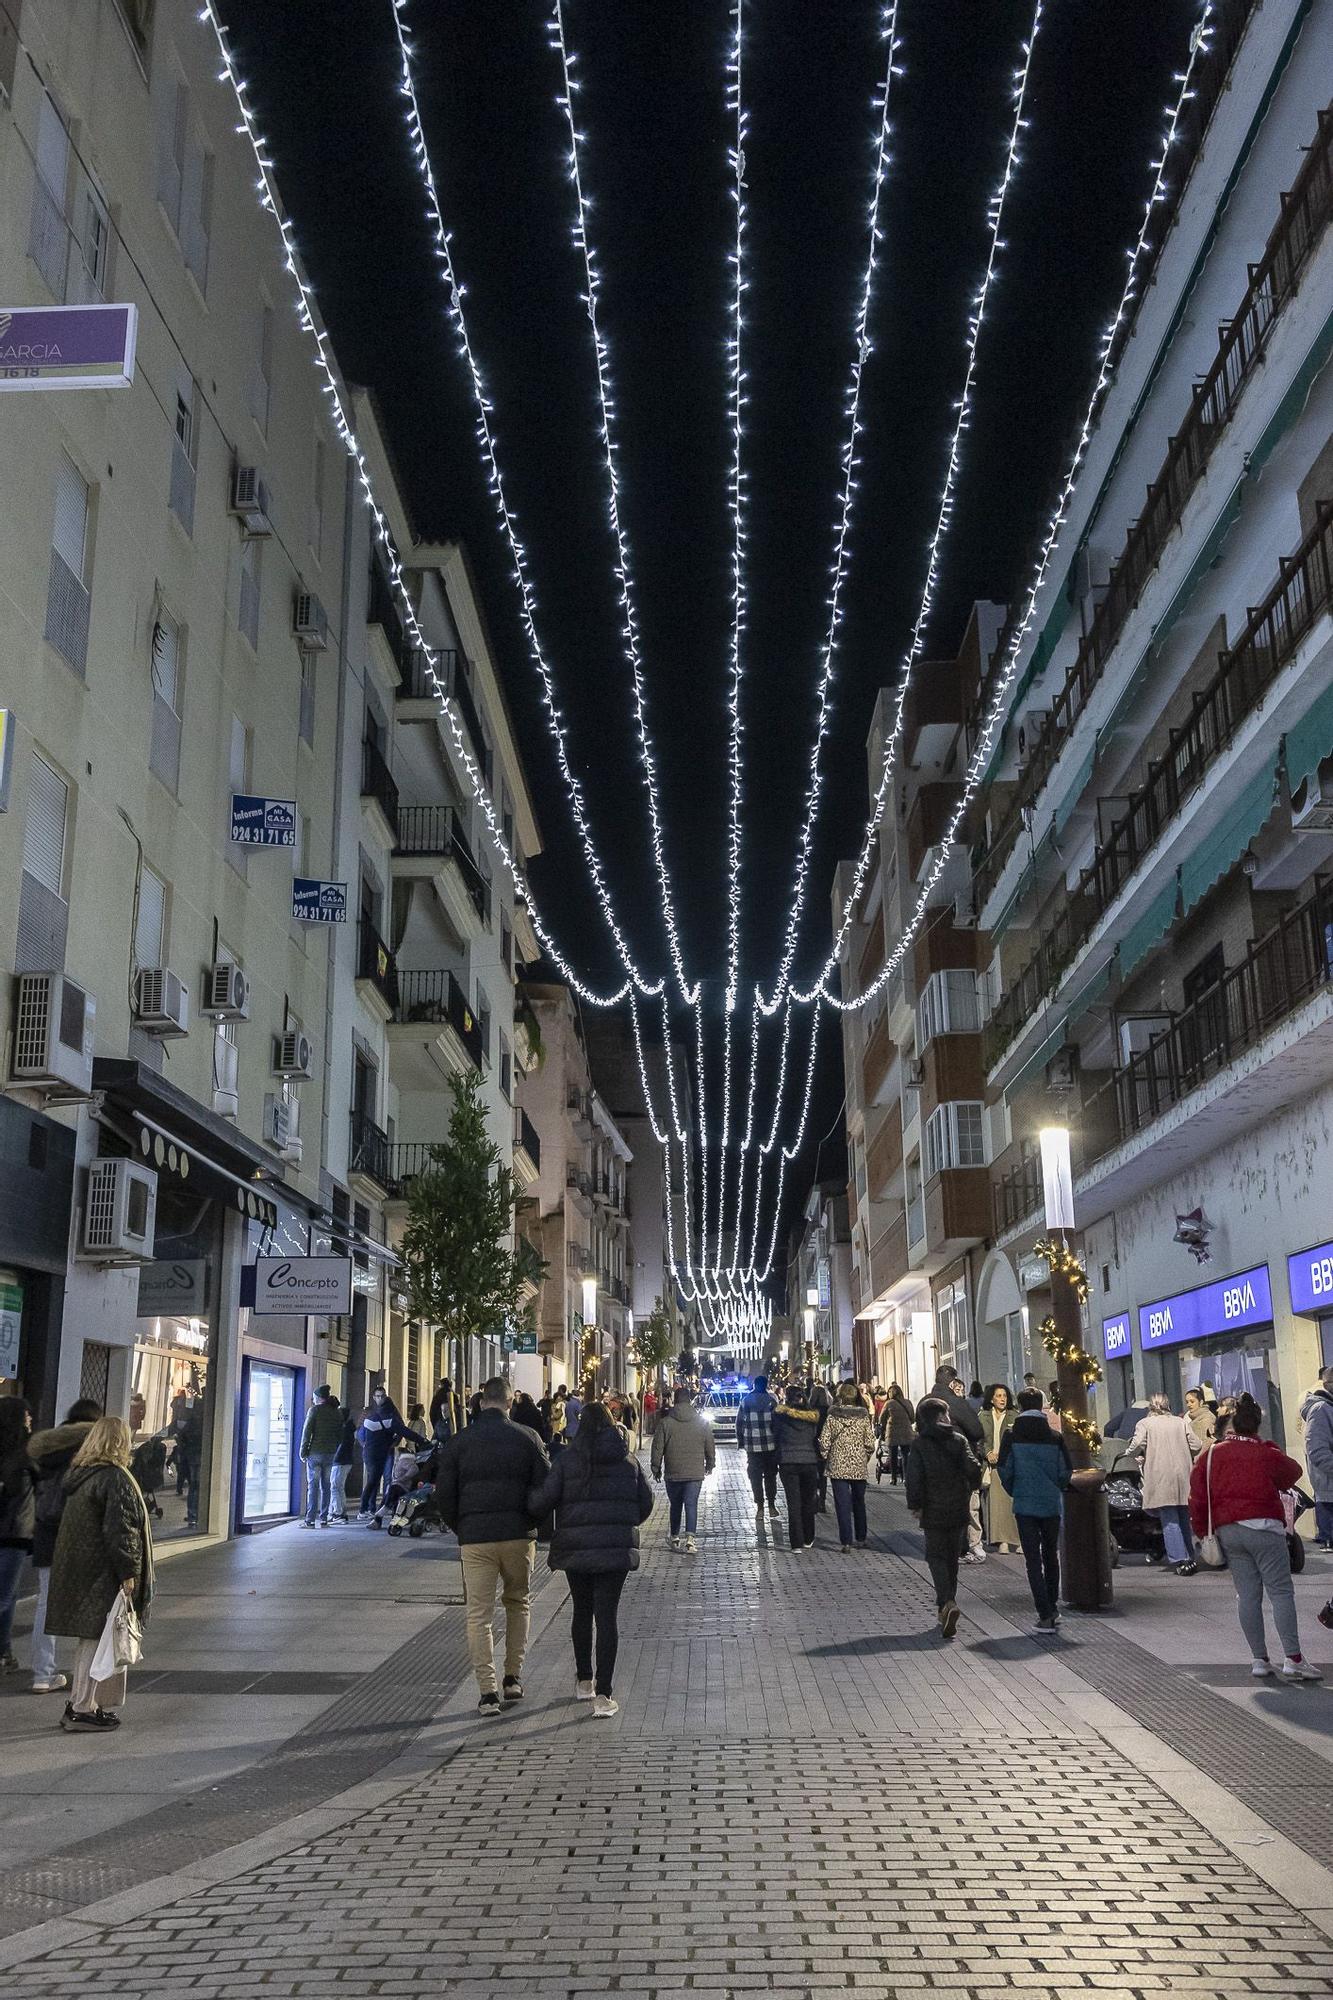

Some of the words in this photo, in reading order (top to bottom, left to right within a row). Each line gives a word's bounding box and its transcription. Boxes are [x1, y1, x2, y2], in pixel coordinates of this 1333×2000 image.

[233, 809, 263, 820] Informa
[267, 815, 291, 823] CASA
[232, 826, 250, 841] 924
[253, 828, 264, 842] 31
[268, 829, 279, 844] 71
[282, 830, 295, 845] 65
[293, 904, 308, 918] 924
[310, 906, 320, 920] 31
[322, 908, 333, 921] 71
[335, 909, 346, 922] 65
[267, 1263, 339, 1289] Concepto
[1310, 1256, 1333, 1295] BB
[1223, 1280, 1256, 1319] BBVA
[1106, 1321, 1126, 1350] BBVA
[1149, 1306, 1174, 1339] BBVA
